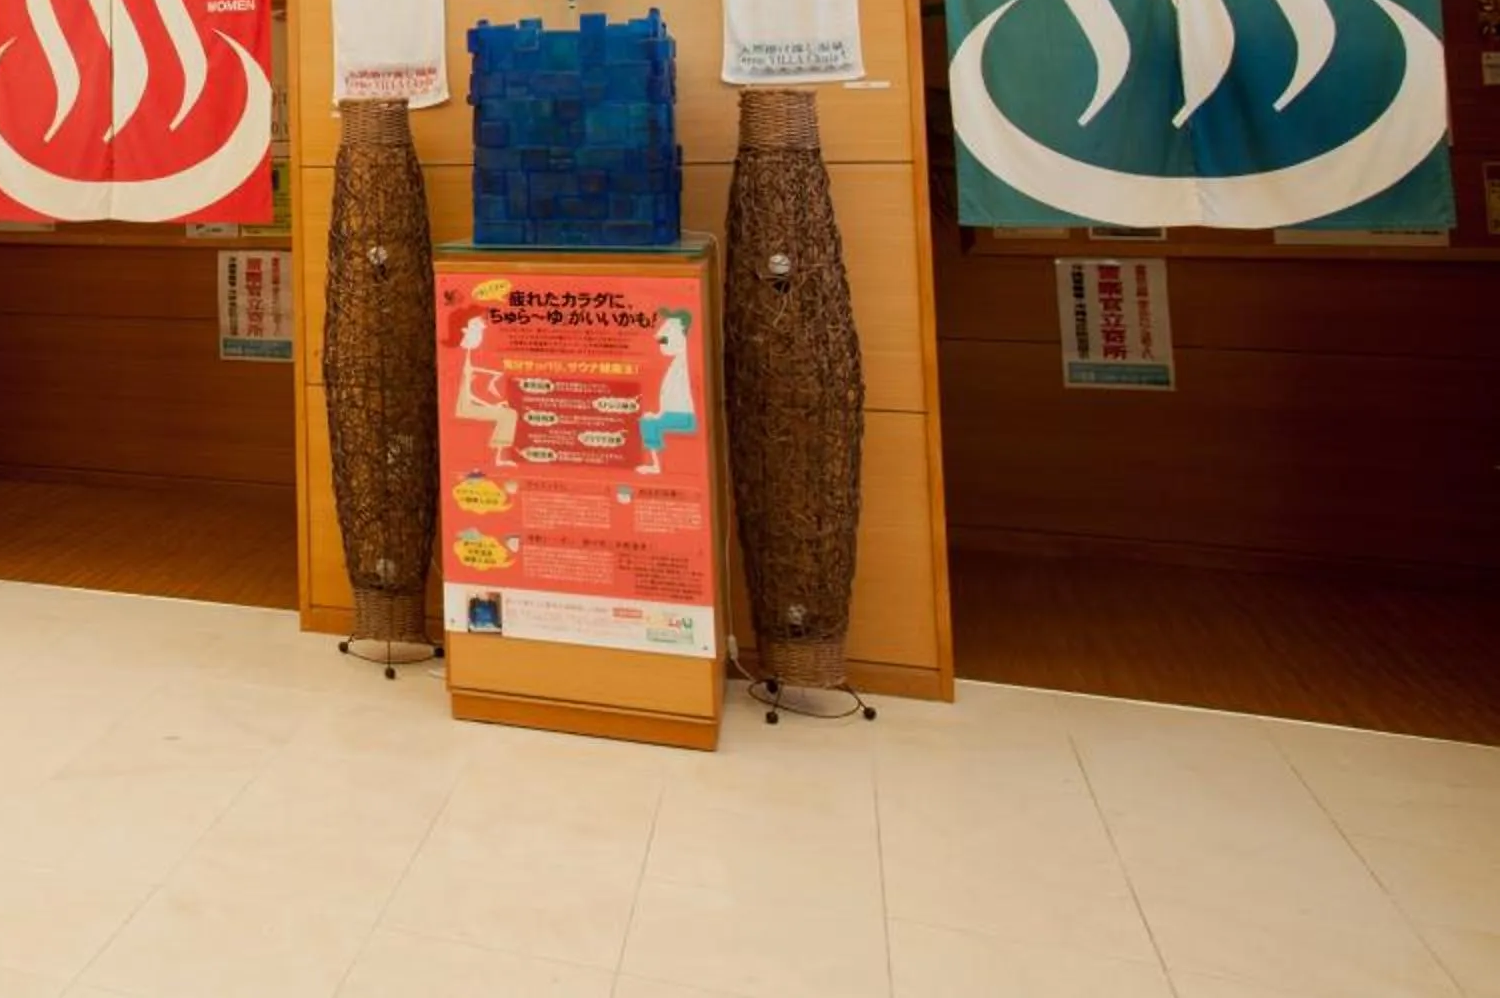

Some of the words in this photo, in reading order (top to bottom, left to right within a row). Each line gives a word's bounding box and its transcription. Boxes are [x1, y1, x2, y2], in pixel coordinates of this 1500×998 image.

[508, 290, 634, 310] 疲れたカラダに、
